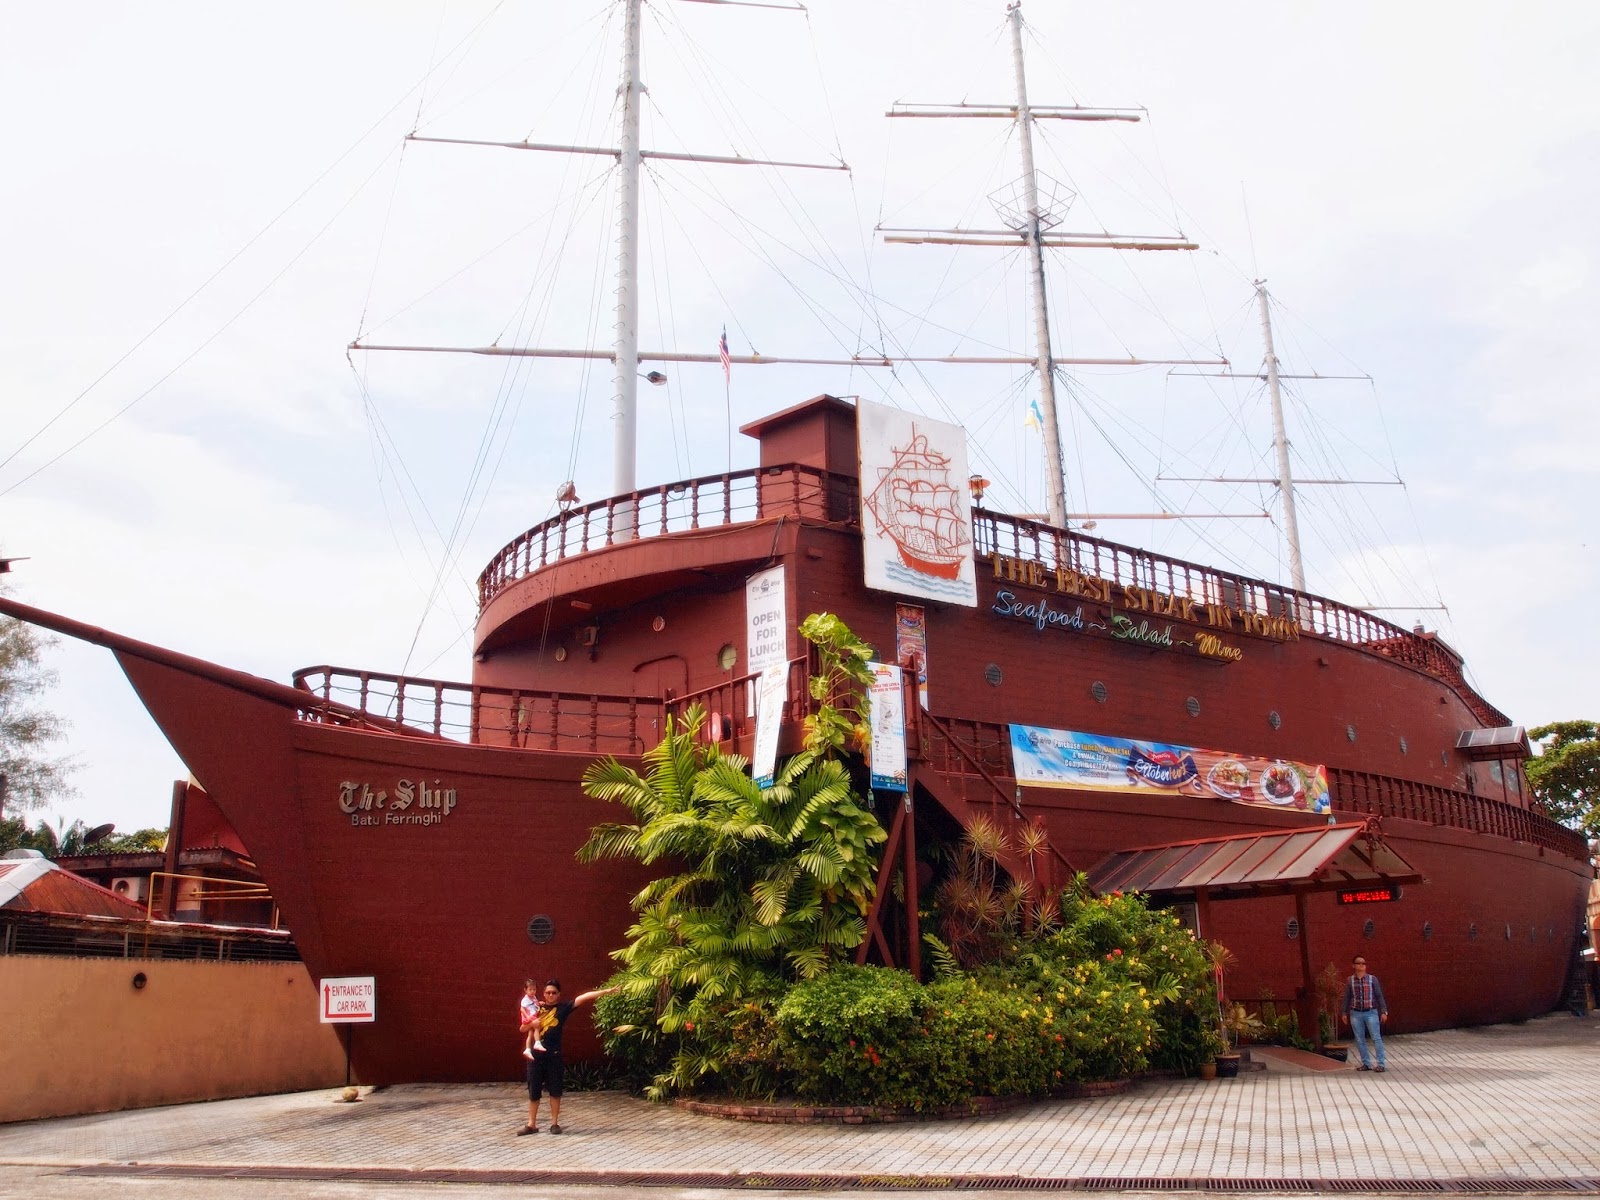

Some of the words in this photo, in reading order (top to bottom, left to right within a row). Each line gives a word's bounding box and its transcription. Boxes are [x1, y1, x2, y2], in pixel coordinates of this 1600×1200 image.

[988, 551, 1047, 587] THE
[1056, 567, 1113, 603] BEST
[1125, 584, 1198, 622] STEAK
[1207, 603, 1232, 628] IN
[1238, 608, 1300, 641] TOWN
[752, 610, 780, 626] OPEN
[756, 626, 777, 640] FOR
[992, 591, 1084, 630] Seafood
[1111, 618, 1174, 646] Salad
[1195, 632, 1243, 661] Wine
[750, 640, 784, 657] LUNCH
[1054, 740, 1080, 750] Purchase
[339, 781, 388, 813] The
[390, 779, 457, 816] Ship
[351, 814, 380, 826] Batu
[385, 812, 441, 826] Ferringhi
[332, 985, 362, 996] ENTRANCE
[364, 985, 372, 995] TO
[337, 1001, 349, 1012] CAR
[351, 1001, 367, 1011] PARK
